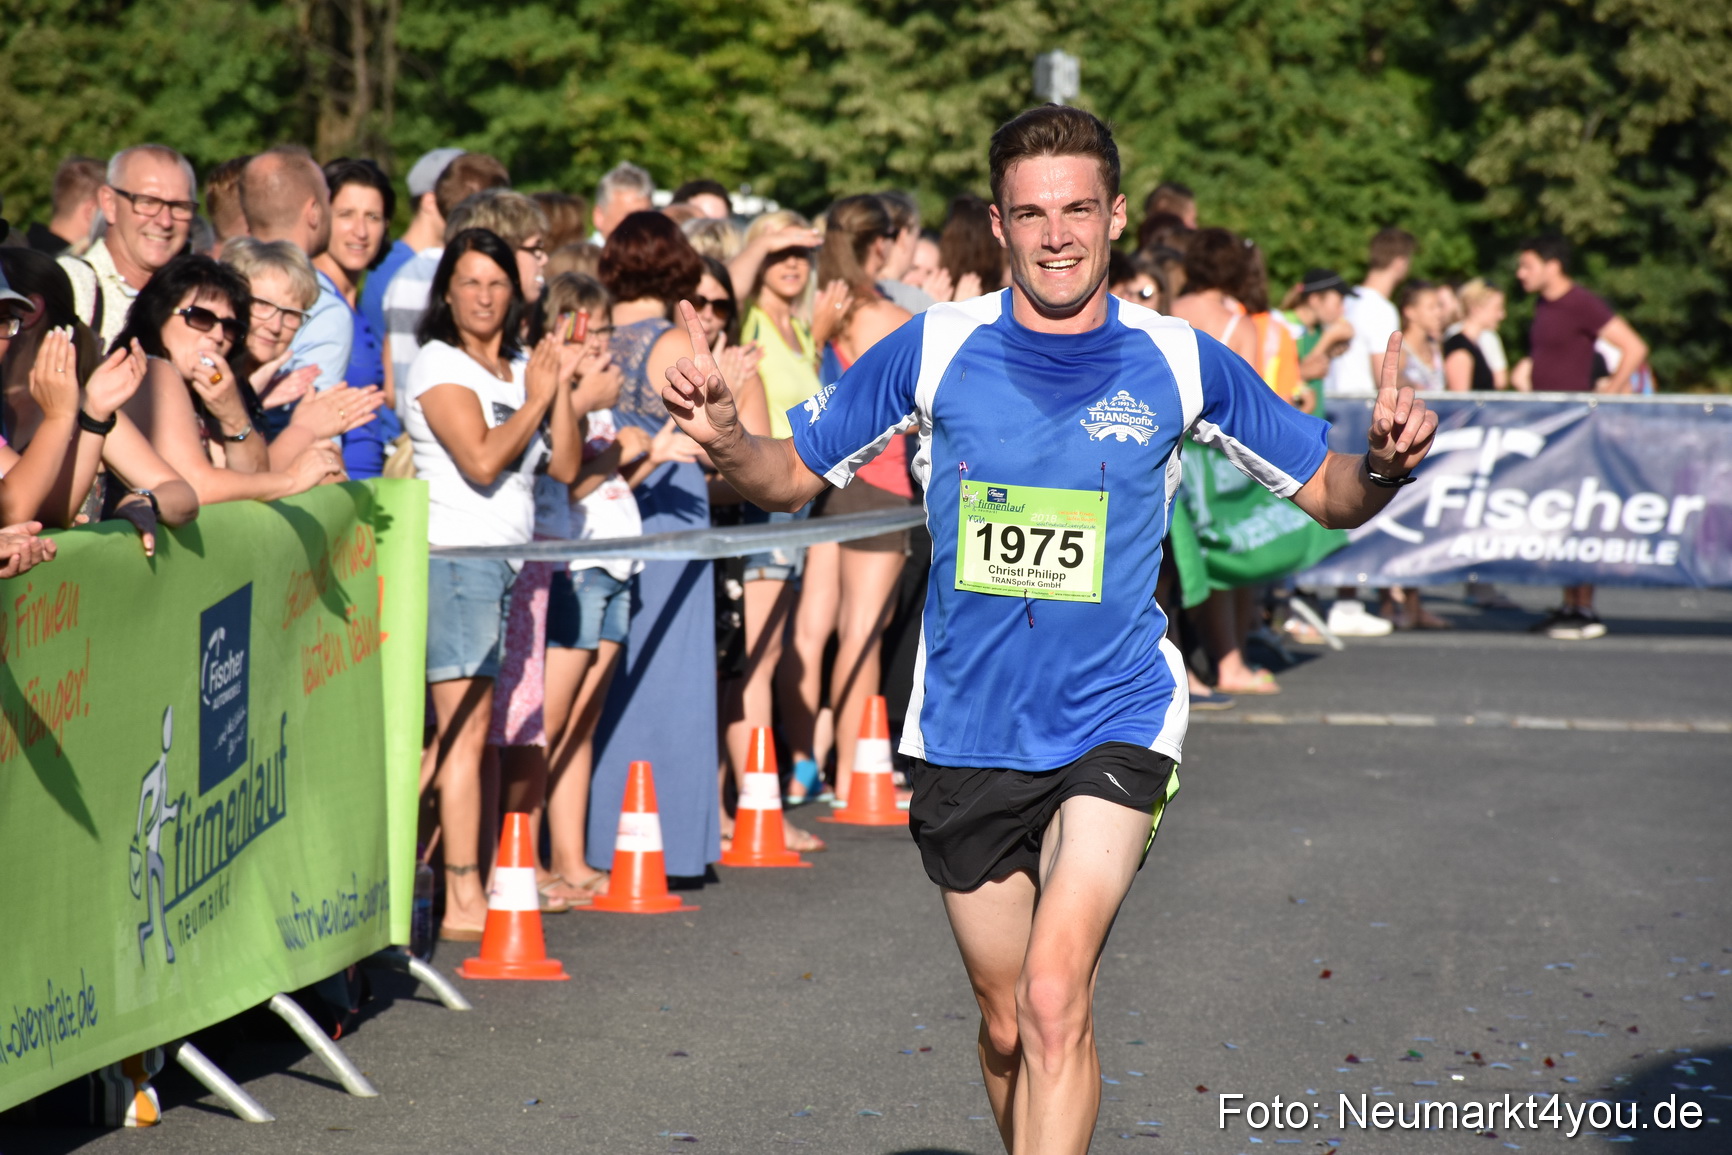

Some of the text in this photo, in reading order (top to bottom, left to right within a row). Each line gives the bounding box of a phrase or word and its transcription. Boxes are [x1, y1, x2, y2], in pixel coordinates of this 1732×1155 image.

[1089, 411, 1153, 427] TRANSpofix
[978, 499, 1026, 513] firmenlauf
[1423, 474, 1705, 535] Fischer
[976, 523, 1084, 569] 1975
[1448, 532, 1680, 566] AUTOMOBILE
[988, 564, 1066, 582] Christl Philipp
[991, 576, 1036, 589] TRANSpofix
[1038, 581, 1062, 589] GmbH
[15, 581, 80, 660] Firmen
[209, 649, 245, 695] Fischer
[24, 637, 90, 759] länger!
[175, 711, 287, 898] firmenlauf
[178, 871, 231, 947] neumarkt
